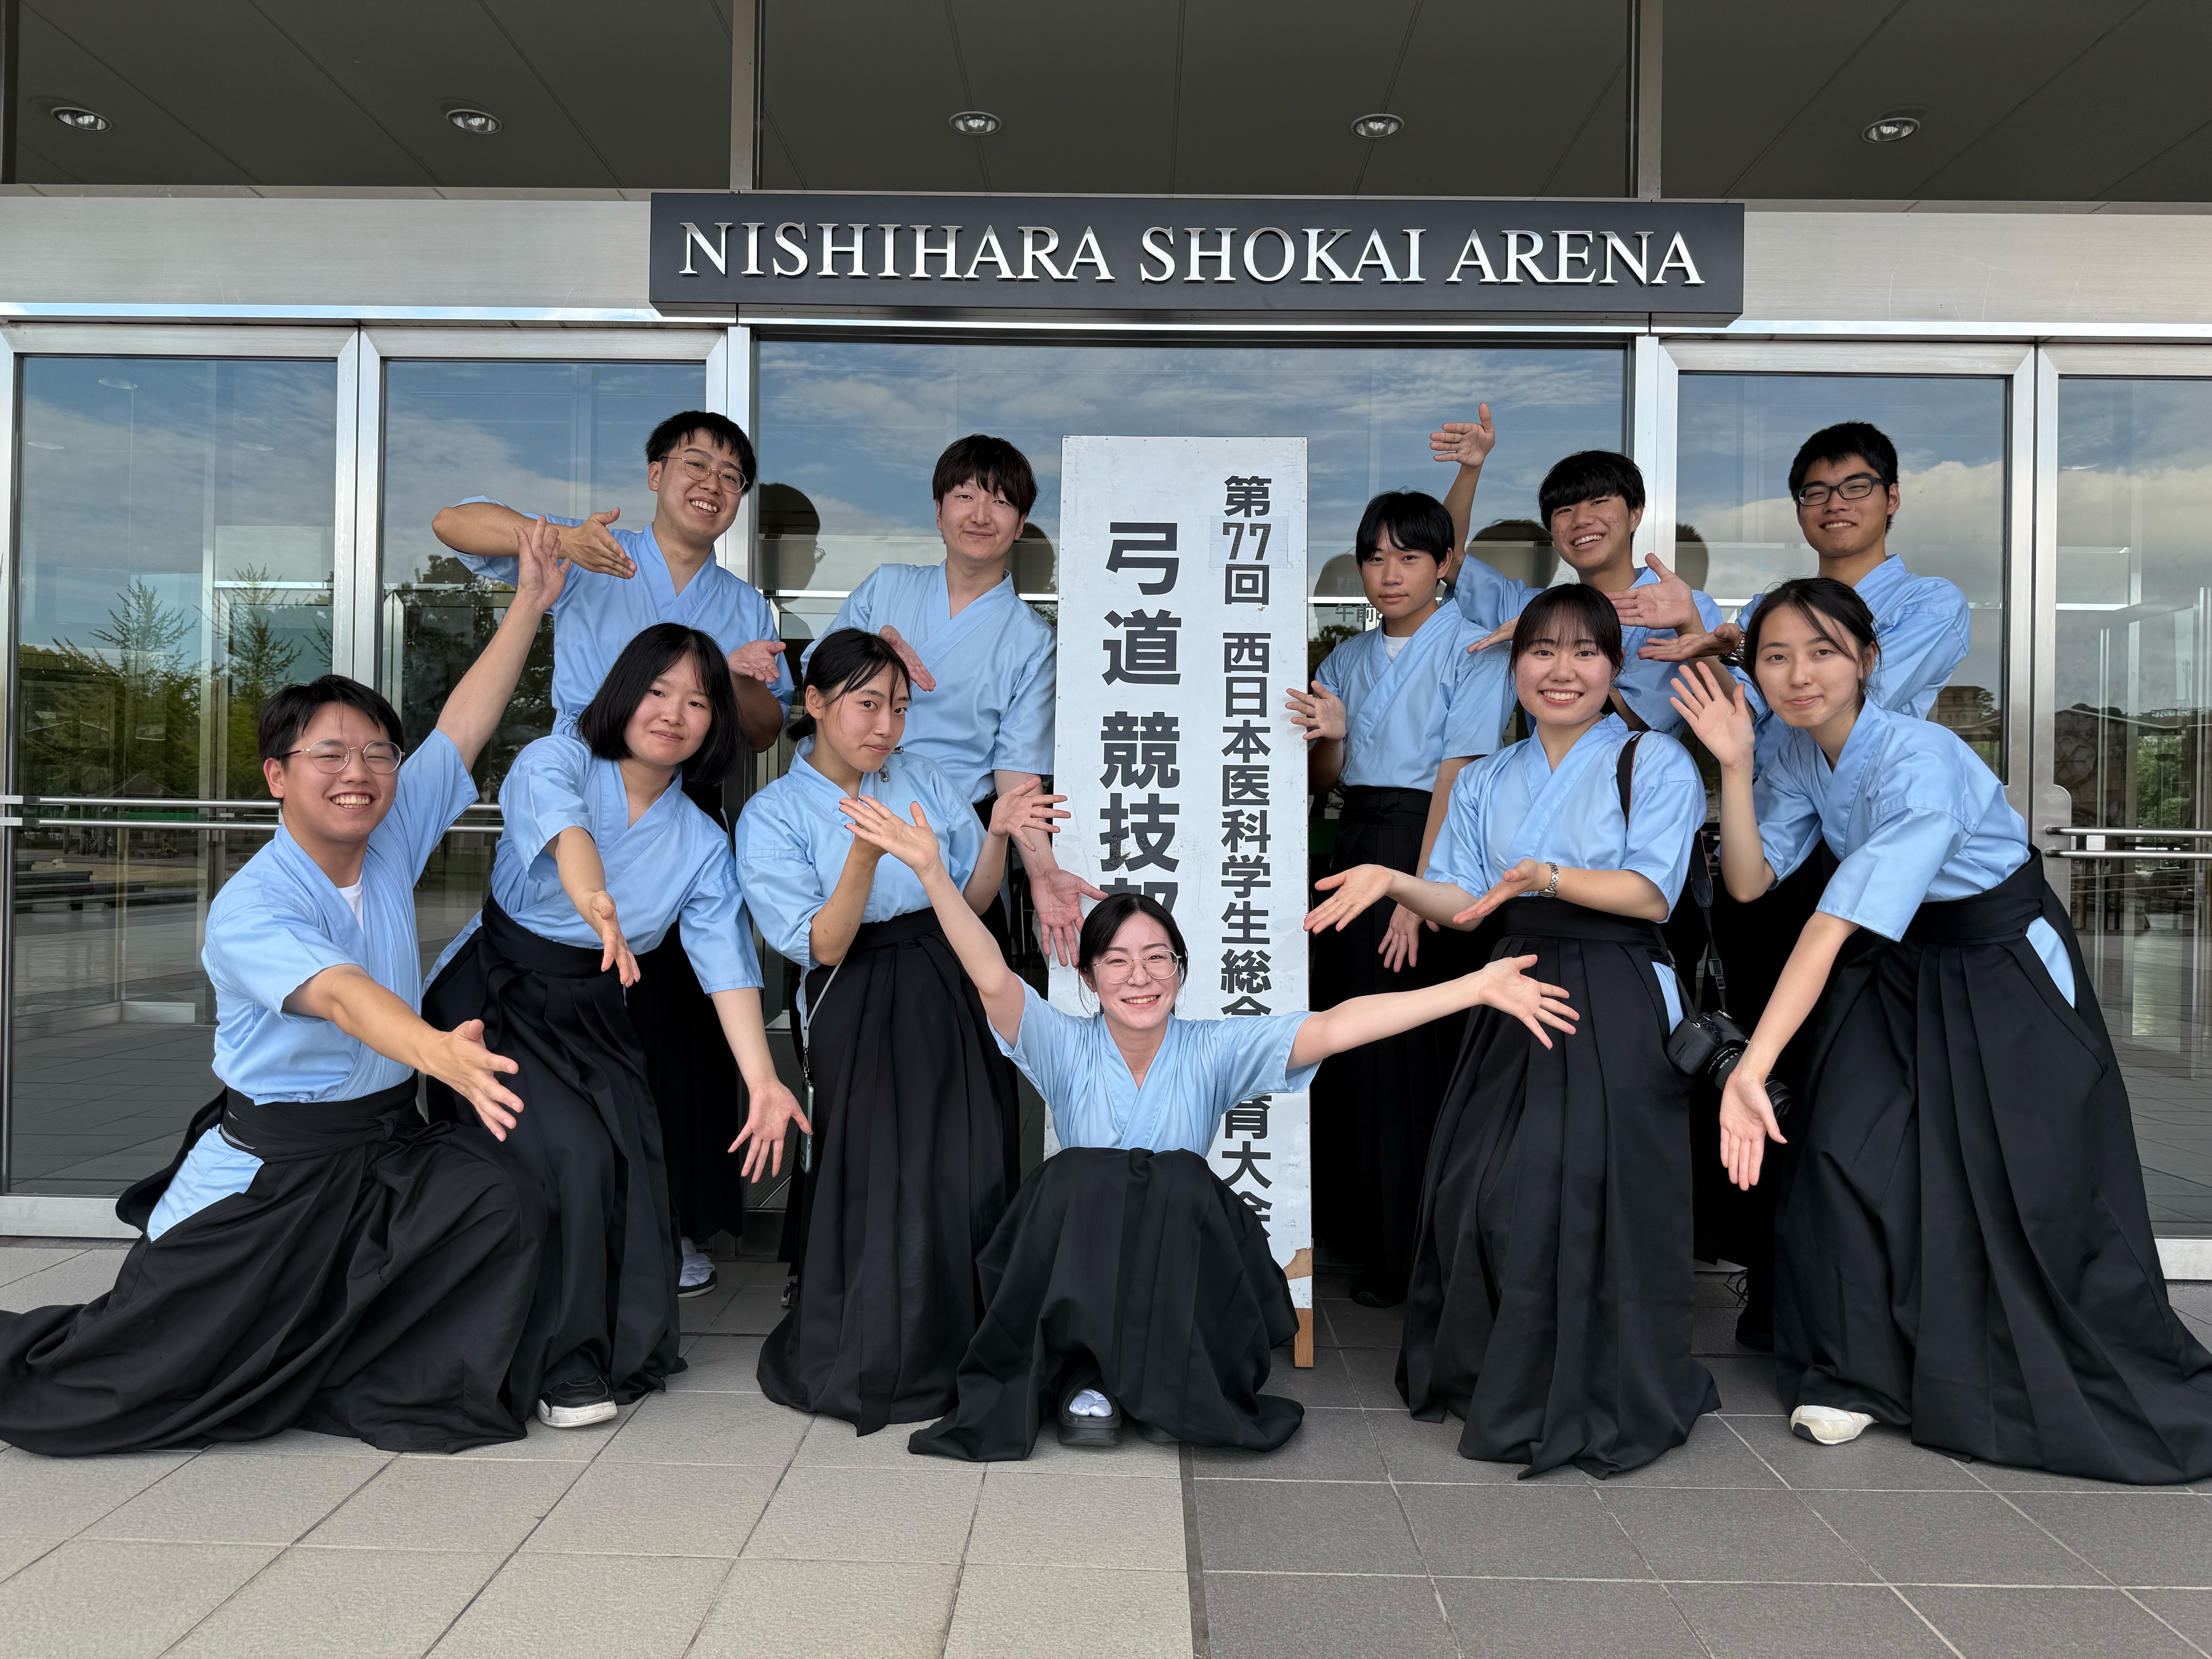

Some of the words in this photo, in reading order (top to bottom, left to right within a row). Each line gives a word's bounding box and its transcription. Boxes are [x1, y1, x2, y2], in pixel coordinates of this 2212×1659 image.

[678, 222, 1115, 280] NISHIHARA
[1140, 227, 1427, 282] SHOKAI
[1446, 229, 1705, 284] ARENA
[1223, 476, 1272, 605] 第77回
[1335, 603, 1383, 622] 午前
[1220, 632, 1273, 1238] 西日本医科学生総育大
